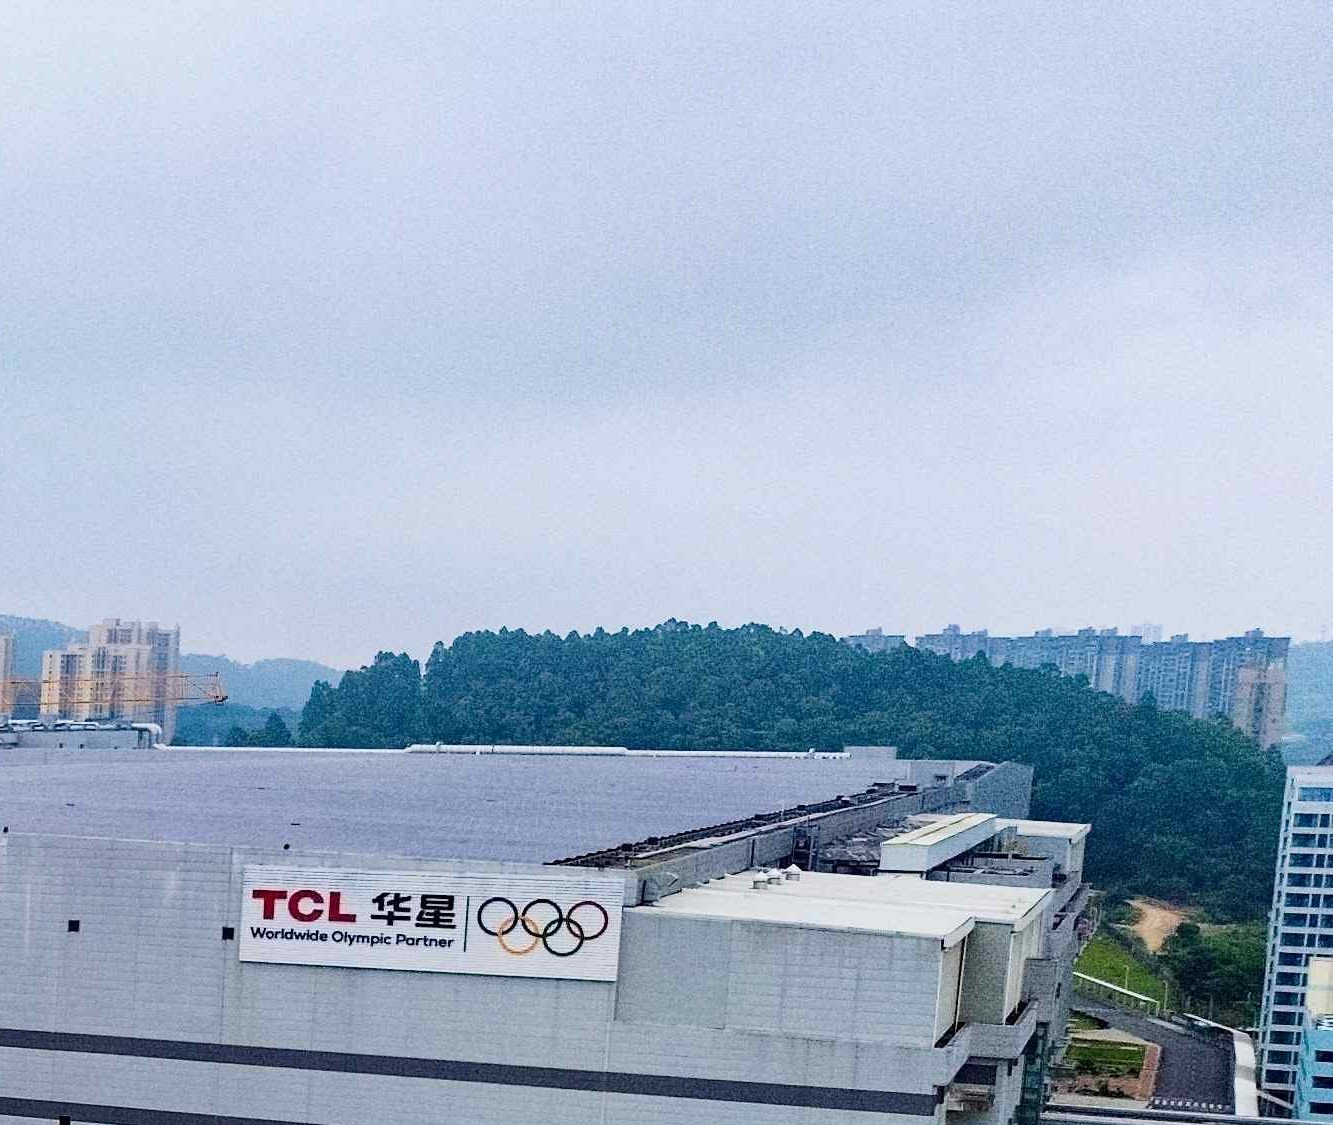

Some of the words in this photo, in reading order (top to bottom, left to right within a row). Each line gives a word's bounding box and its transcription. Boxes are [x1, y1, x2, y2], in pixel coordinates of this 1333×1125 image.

[252, 889, 357, 922] TCL
[370, 892, 457, 929] 华星
[250, 927, 328, 942] Worldwide
[332, 930, 391, 946] Olympic
[395, 934, 454, 948] Partner
